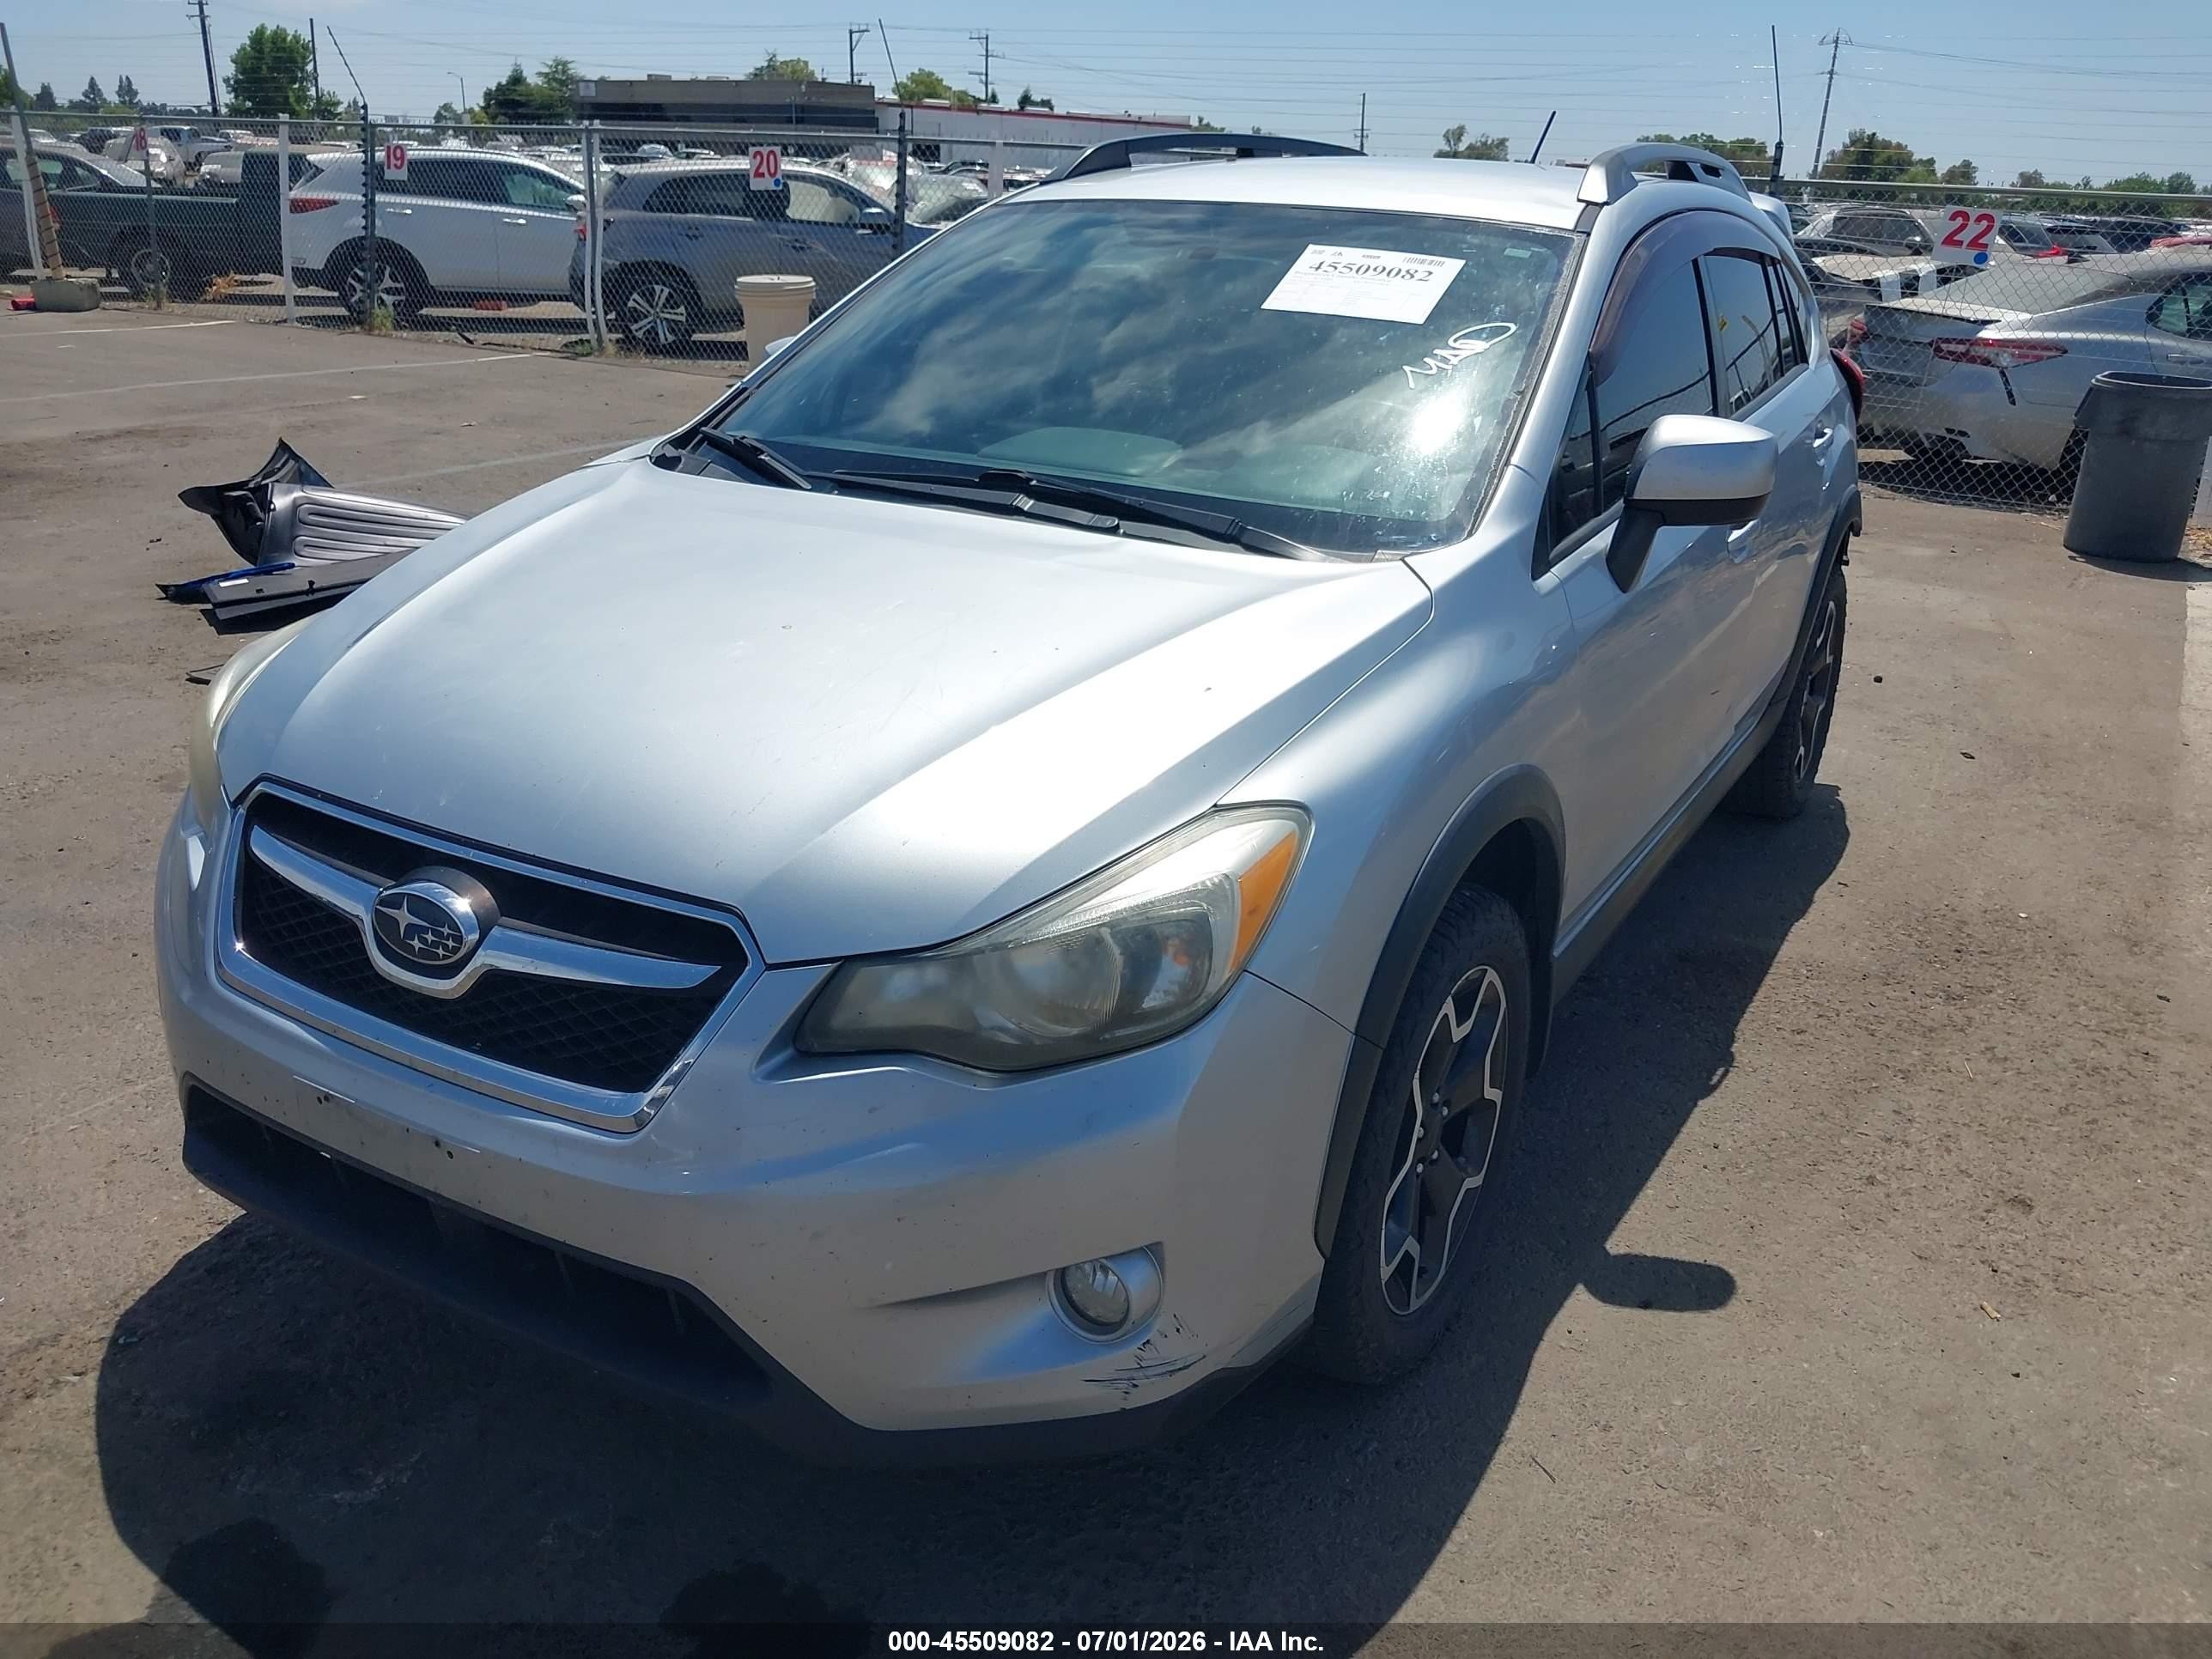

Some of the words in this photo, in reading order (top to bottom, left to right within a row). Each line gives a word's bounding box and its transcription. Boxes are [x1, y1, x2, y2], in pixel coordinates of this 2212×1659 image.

[386, 144, 405, 170] 19
[752, 149, 778, 179] 20
[1941, 210, 1996, 252] 22
[1308, 259, 1435, 283] 45509082
